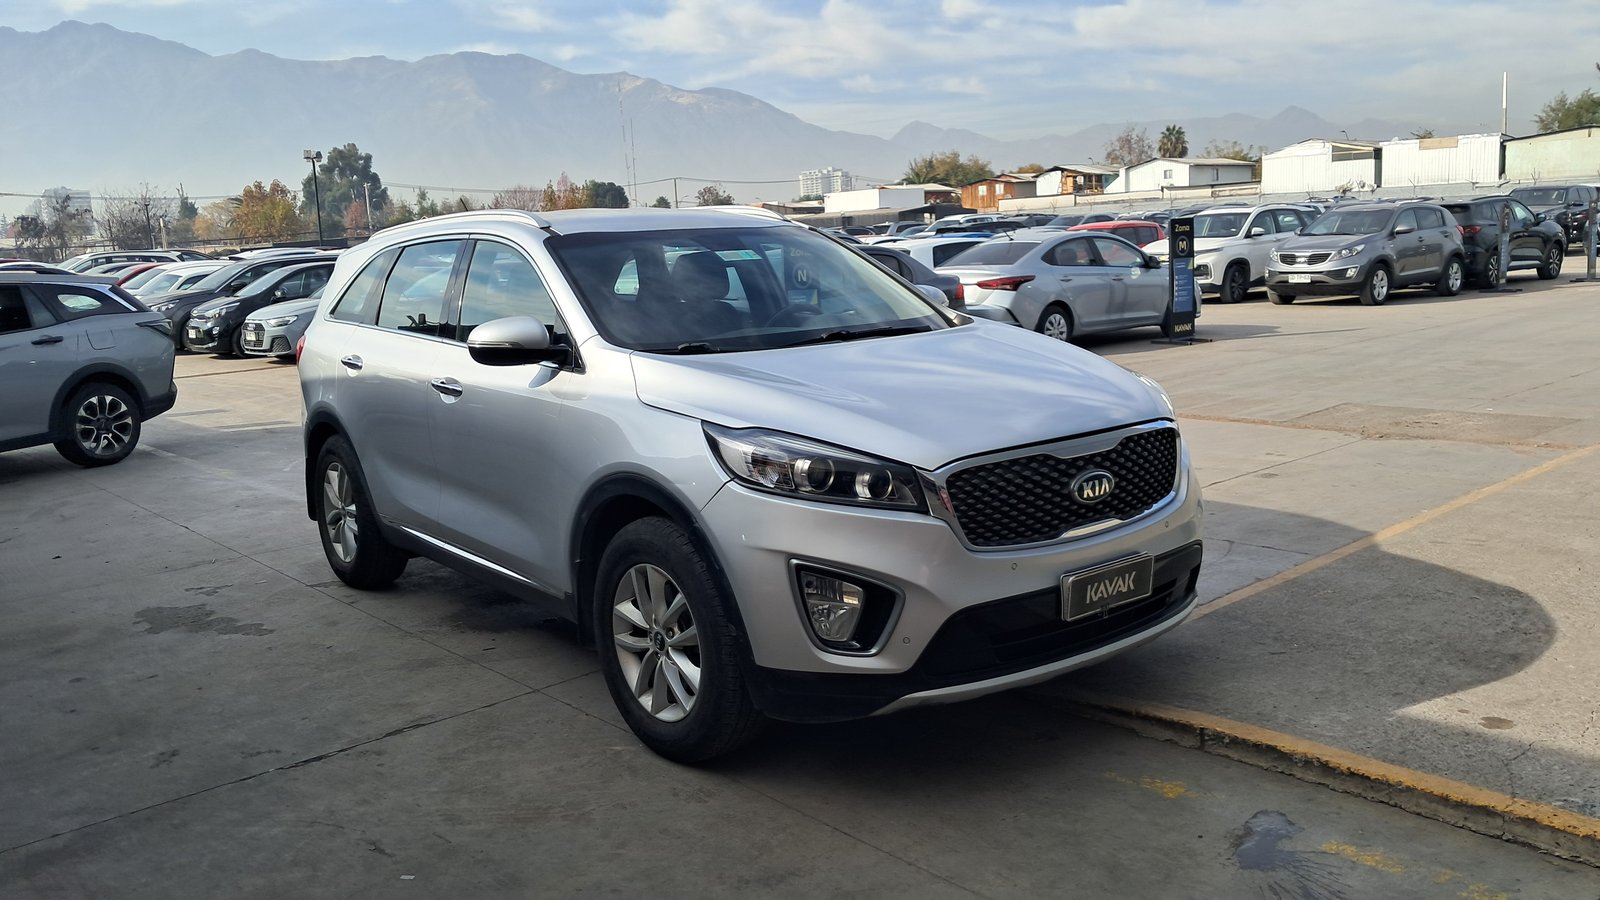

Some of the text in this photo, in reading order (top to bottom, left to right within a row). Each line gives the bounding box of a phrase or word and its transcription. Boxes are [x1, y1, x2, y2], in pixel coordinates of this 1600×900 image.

[1175, 224, 1190, 232] Zona
[1178, 240, 1187, 251] M
[797, 269, 807, 282] N
[1174, 323, 1192, 333] KAVAK
[1082, 478, 1110, 499] KIA
[1086, 571, 1136, 604] KAVAK
